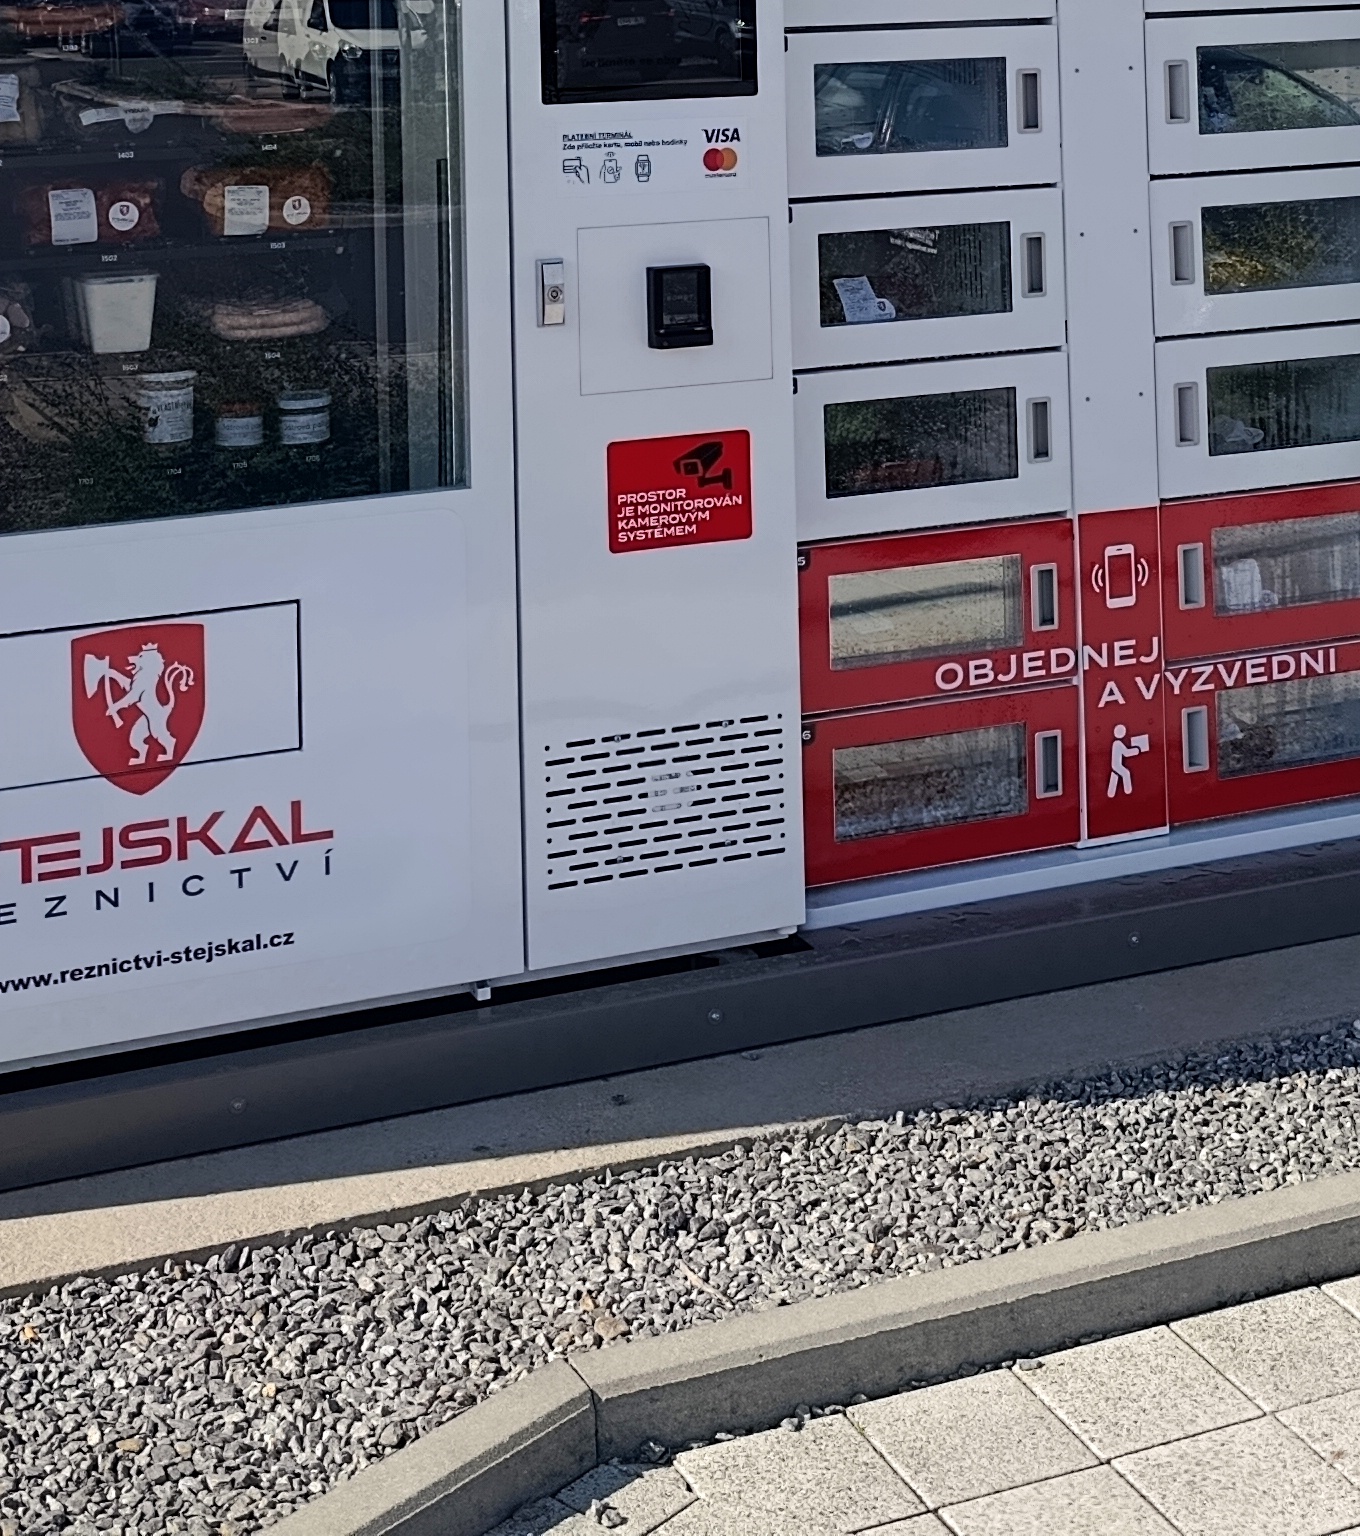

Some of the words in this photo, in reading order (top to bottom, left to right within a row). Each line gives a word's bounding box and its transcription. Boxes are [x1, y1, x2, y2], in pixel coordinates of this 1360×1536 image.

[701, 127, 741, 144] VISA
[617, 488, 686, 505] PROSTOR
[617, 506, 635, 518] JE
[638, 493, 742, 516] MONITOROVÁN
[618, 509, 710, 530] KAMEROVÝM
[618, 524, 697, 543] SYSTÉMEM
[936, 636, 1159, 691] OBJEDNEJ
[1098, 681, 1125, 708] A
[1135, 647, 1336, 700] VYZVEDNI
